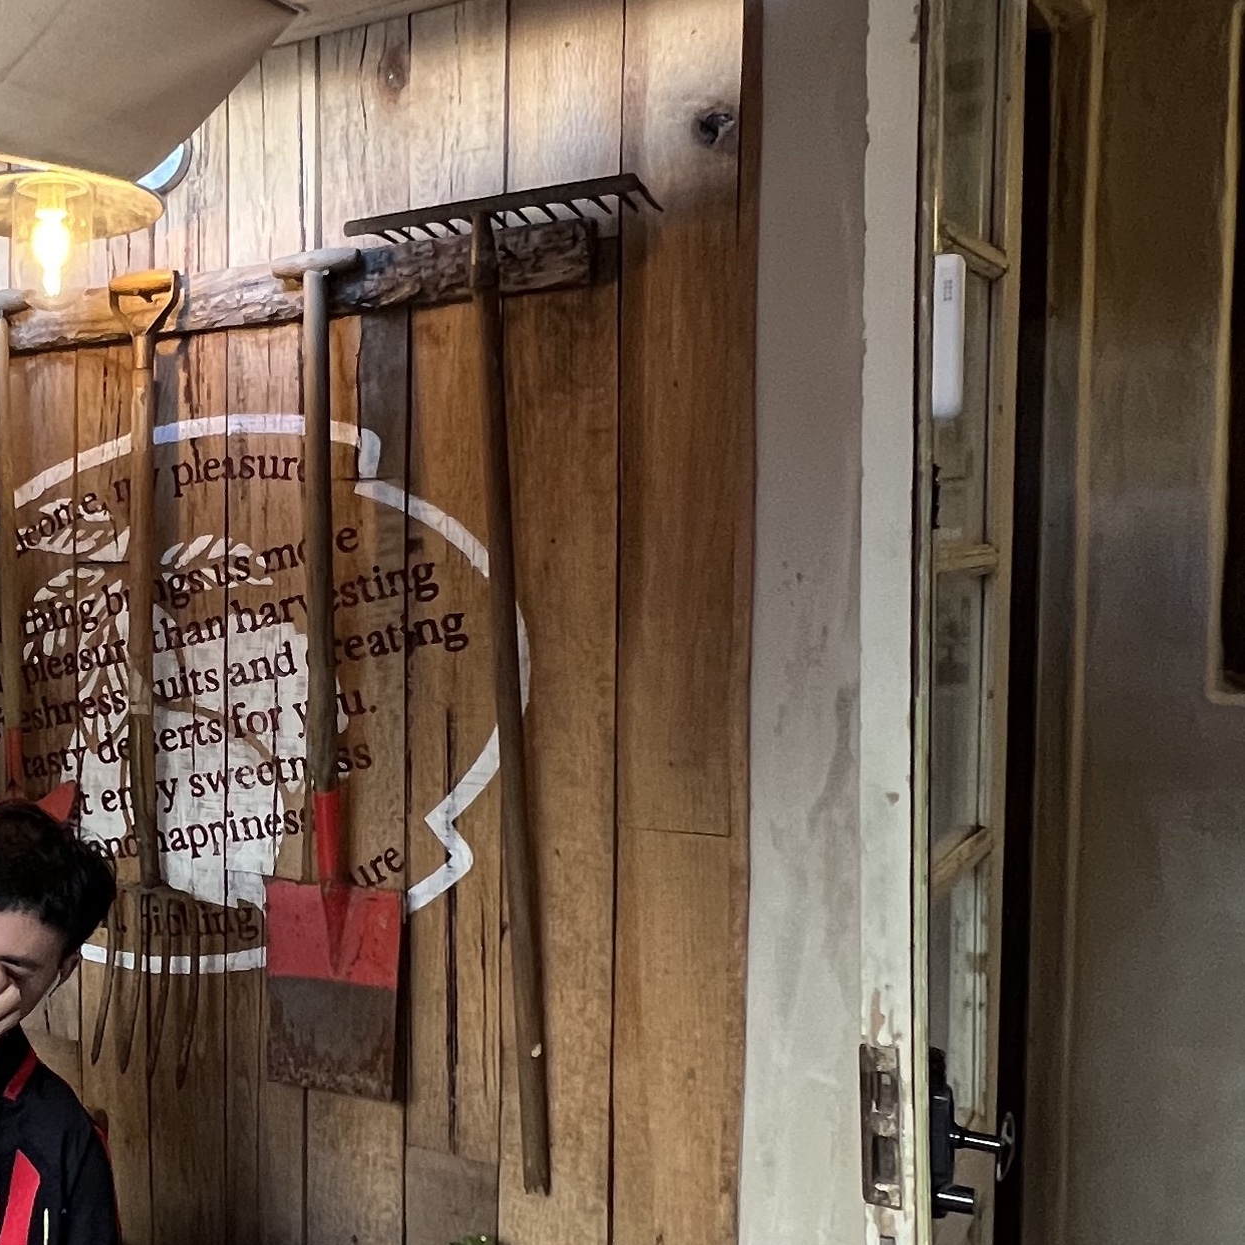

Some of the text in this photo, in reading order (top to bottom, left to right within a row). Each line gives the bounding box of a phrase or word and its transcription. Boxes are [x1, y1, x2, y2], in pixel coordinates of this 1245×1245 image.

[214, 555, 251, 584] us
[260, 525, 359, 576] me
[21, 637, 126, 694] pleasur
[154, 666, 221, 702] uits
[229, 641, 299, 688] and
[332, 611, 470, 664] eating
[97, 718, 223, 764] deerts
[229, 701, 283, 740] for
[292, 689, 377, 740] yu.
[188, 742, 373, 799] sweetnss
